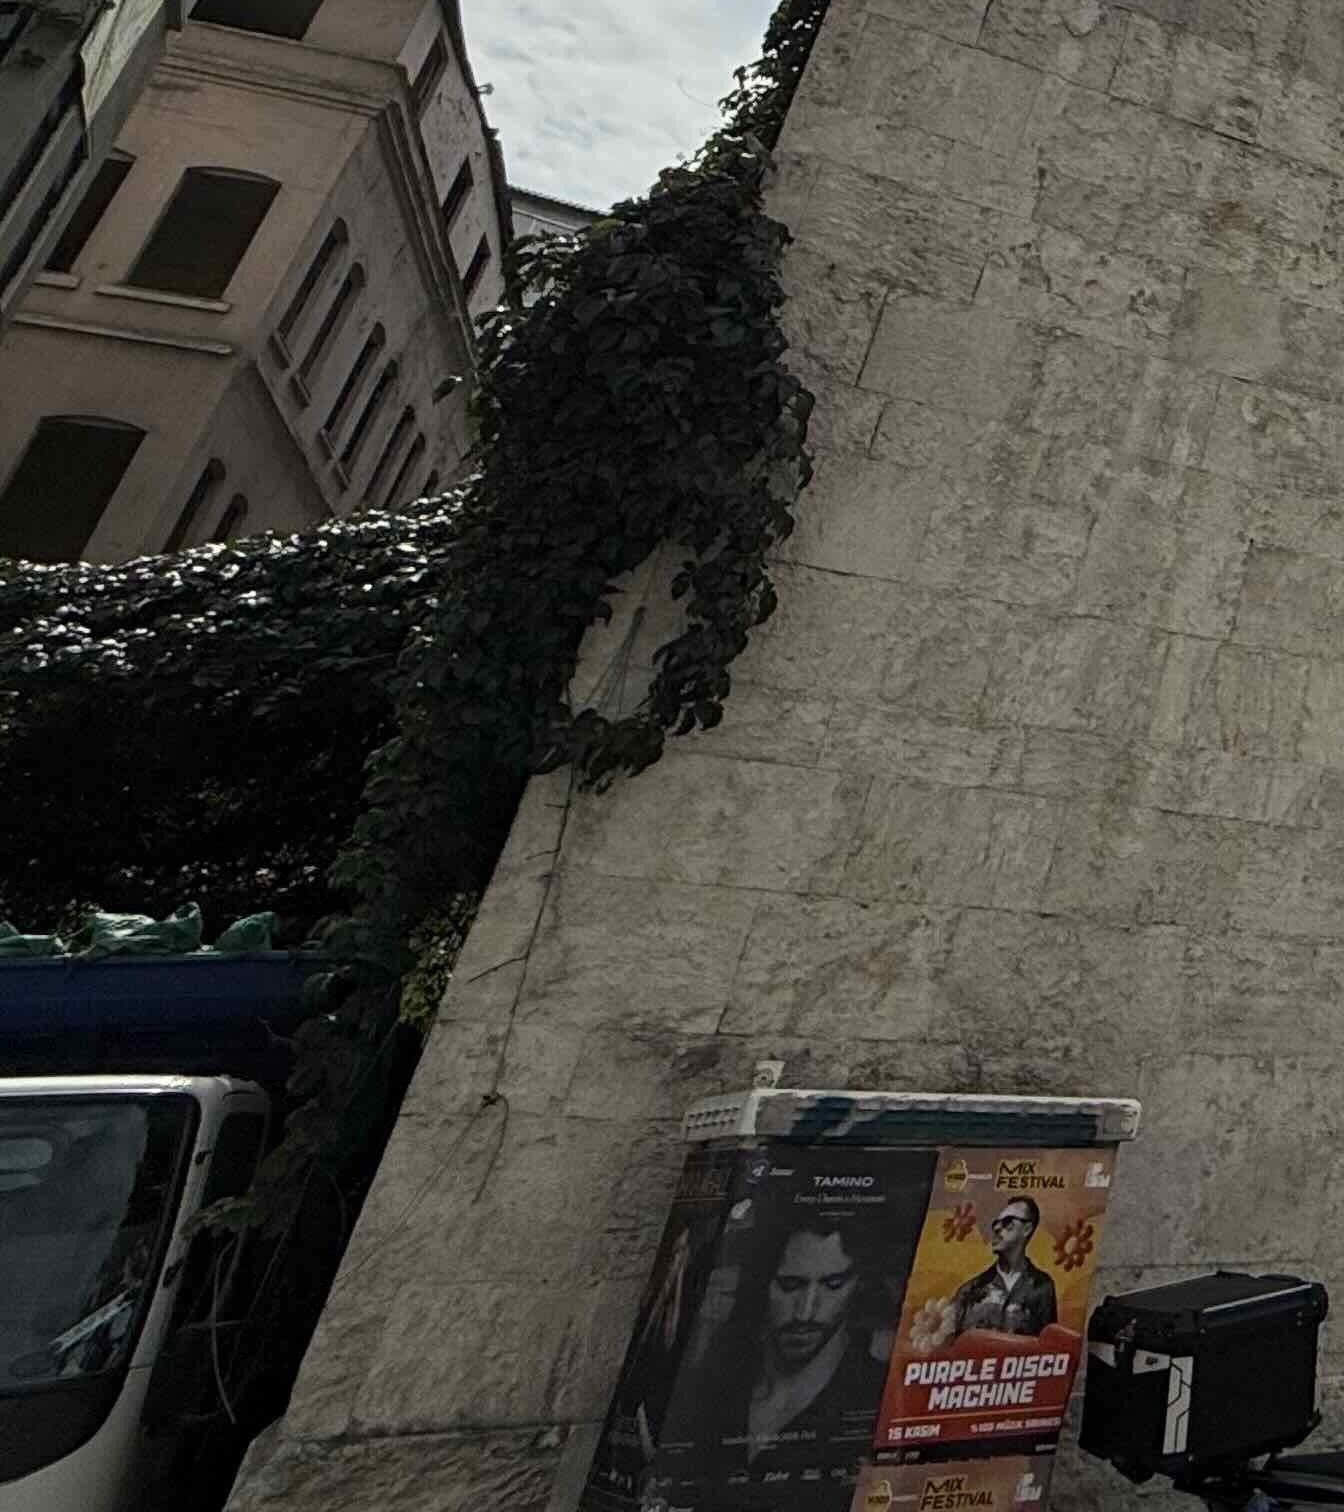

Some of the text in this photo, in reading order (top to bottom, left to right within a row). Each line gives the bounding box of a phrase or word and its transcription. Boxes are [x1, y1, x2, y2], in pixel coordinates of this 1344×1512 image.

[999, 1161, 1037, 1175] MIX
[813, 1175, 875, 1188] TAMINO
[996, 1175, 1066, 1189] FESTIVAL
[903, 1353, 1071, 1386] PURPLE DISCO
[927, 1380, 1037, 1411] MACHINE
[888, 1426, 902, 1441] 15
[924, 1477, 965, 1493] MIX
[920, 1491, 994, 1511] FESTIVAL
